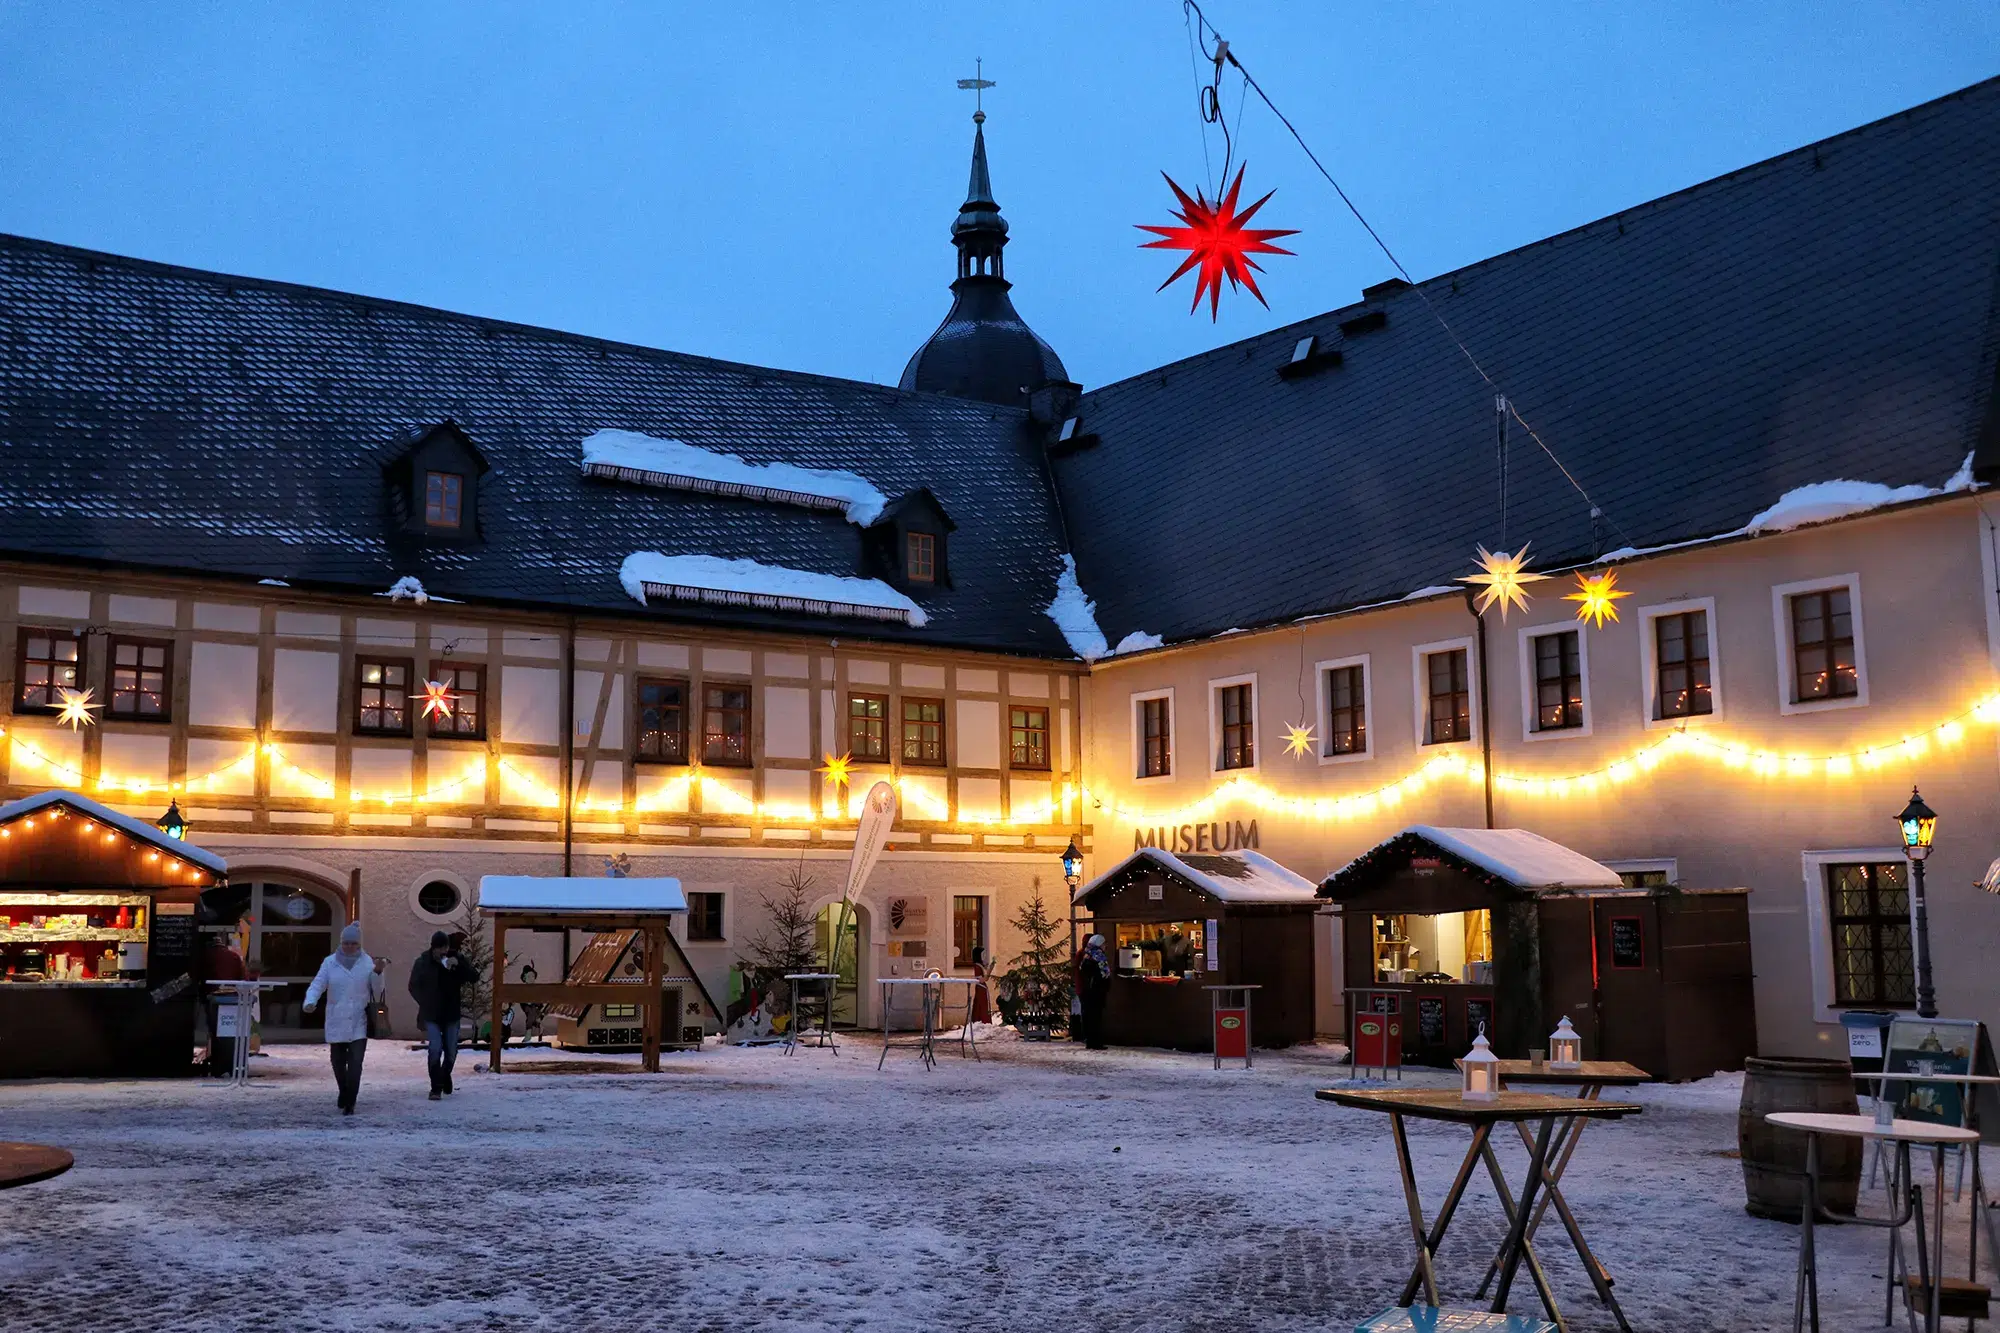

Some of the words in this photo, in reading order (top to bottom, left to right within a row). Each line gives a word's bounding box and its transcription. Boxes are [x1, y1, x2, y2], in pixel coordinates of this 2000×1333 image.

[848, 850, 867, 895] Stadtmuseum
[864, 816, 878, 849] Olbernhau
[1134, 819, 1259, 853] MUSEUM
